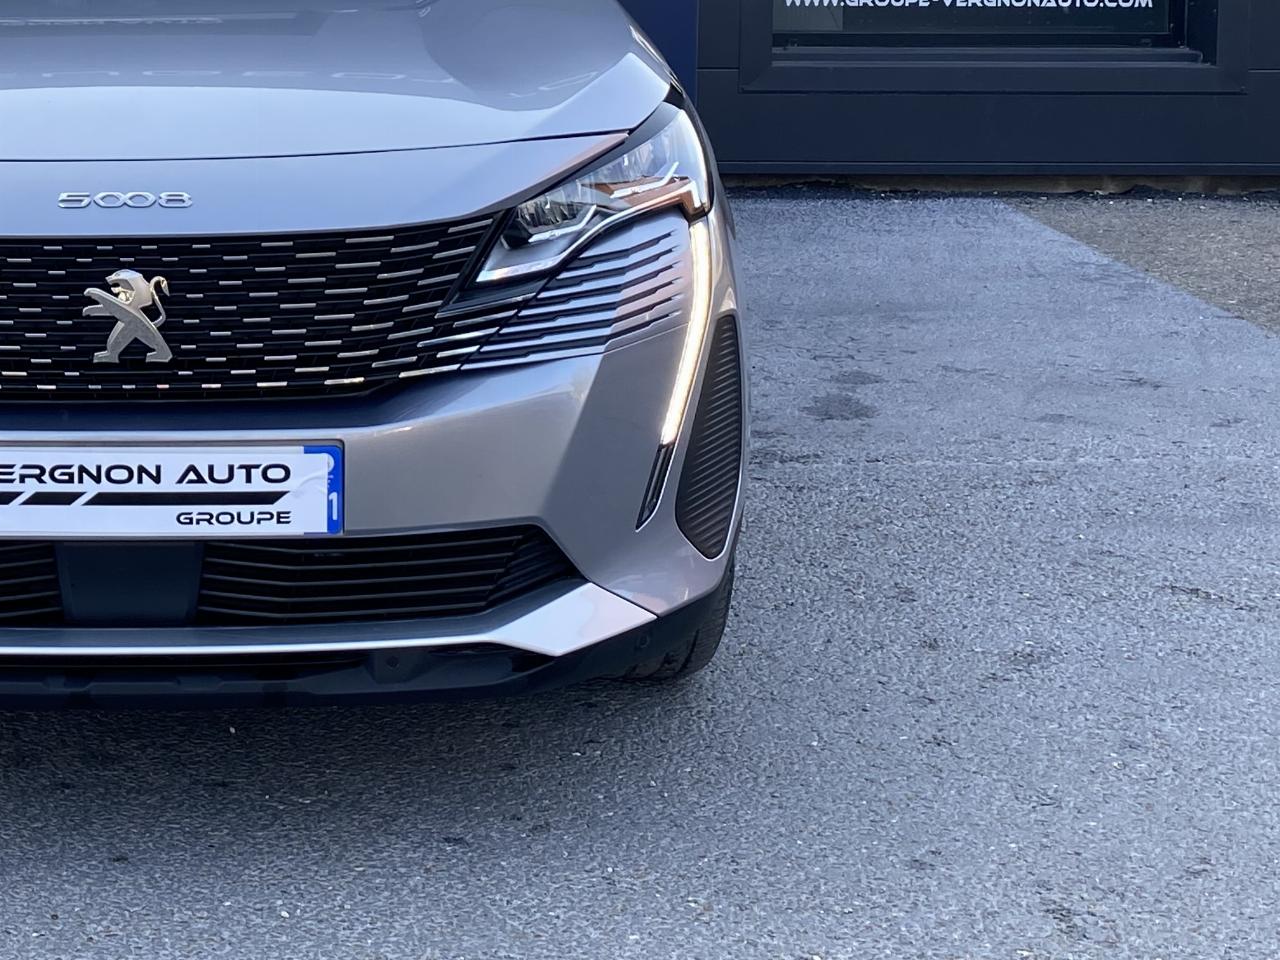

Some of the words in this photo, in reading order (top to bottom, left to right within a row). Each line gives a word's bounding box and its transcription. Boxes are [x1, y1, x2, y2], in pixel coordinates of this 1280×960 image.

[58, 192, 192, 208] 5008
[176, 463, 291, 484] AUTO
[176, 511, 292, 525] GROUPE
